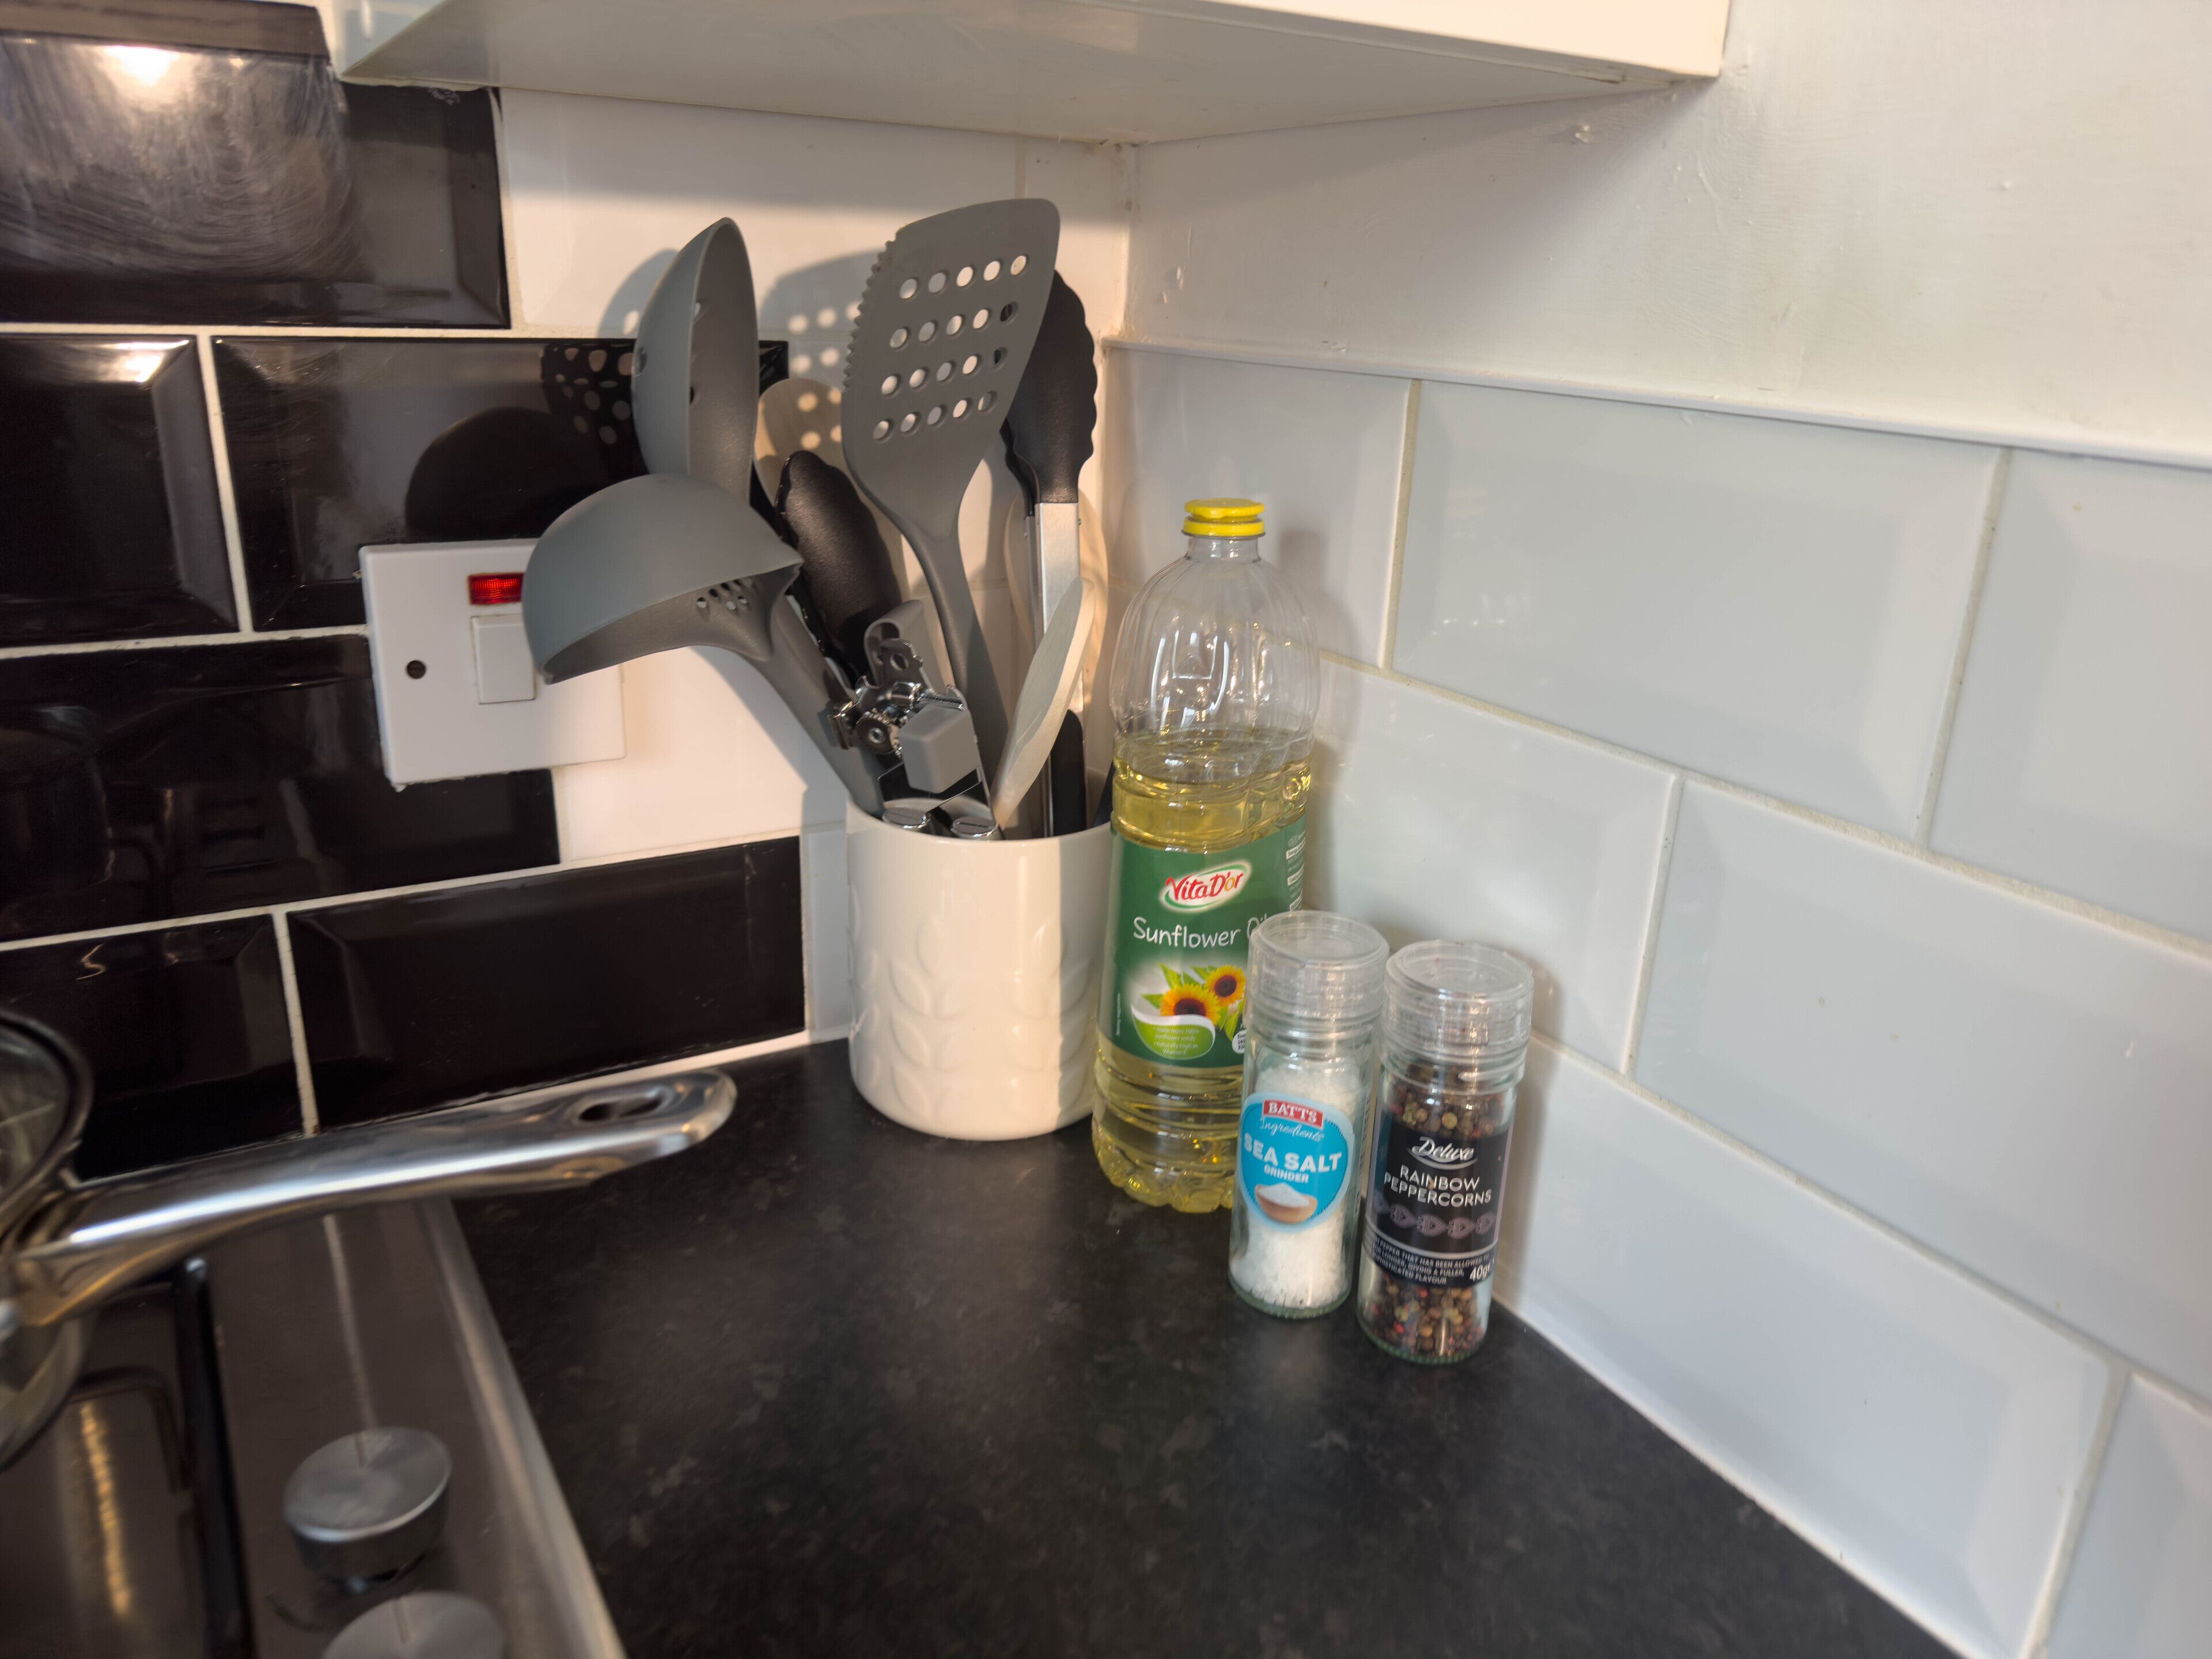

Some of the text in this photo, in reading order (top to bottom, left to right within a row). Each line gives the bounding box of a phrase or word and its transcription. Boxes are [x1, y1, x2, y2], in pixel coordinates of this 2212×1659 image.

[1133, 916, 1241, 949] Sunflower
[1268, 1101, 1317, 1123] BATTS
[1244, 1132, 1342, 1173] SEA SALT
[1412, 1136, 1474, 1163] Deluxe
[1264, 1164, 1309, 1183] GRINDER
[1400, 1164, 1479, 1192] RAINBOW
[1384, 1171, 1492, 1207] PEPPERCORNS
